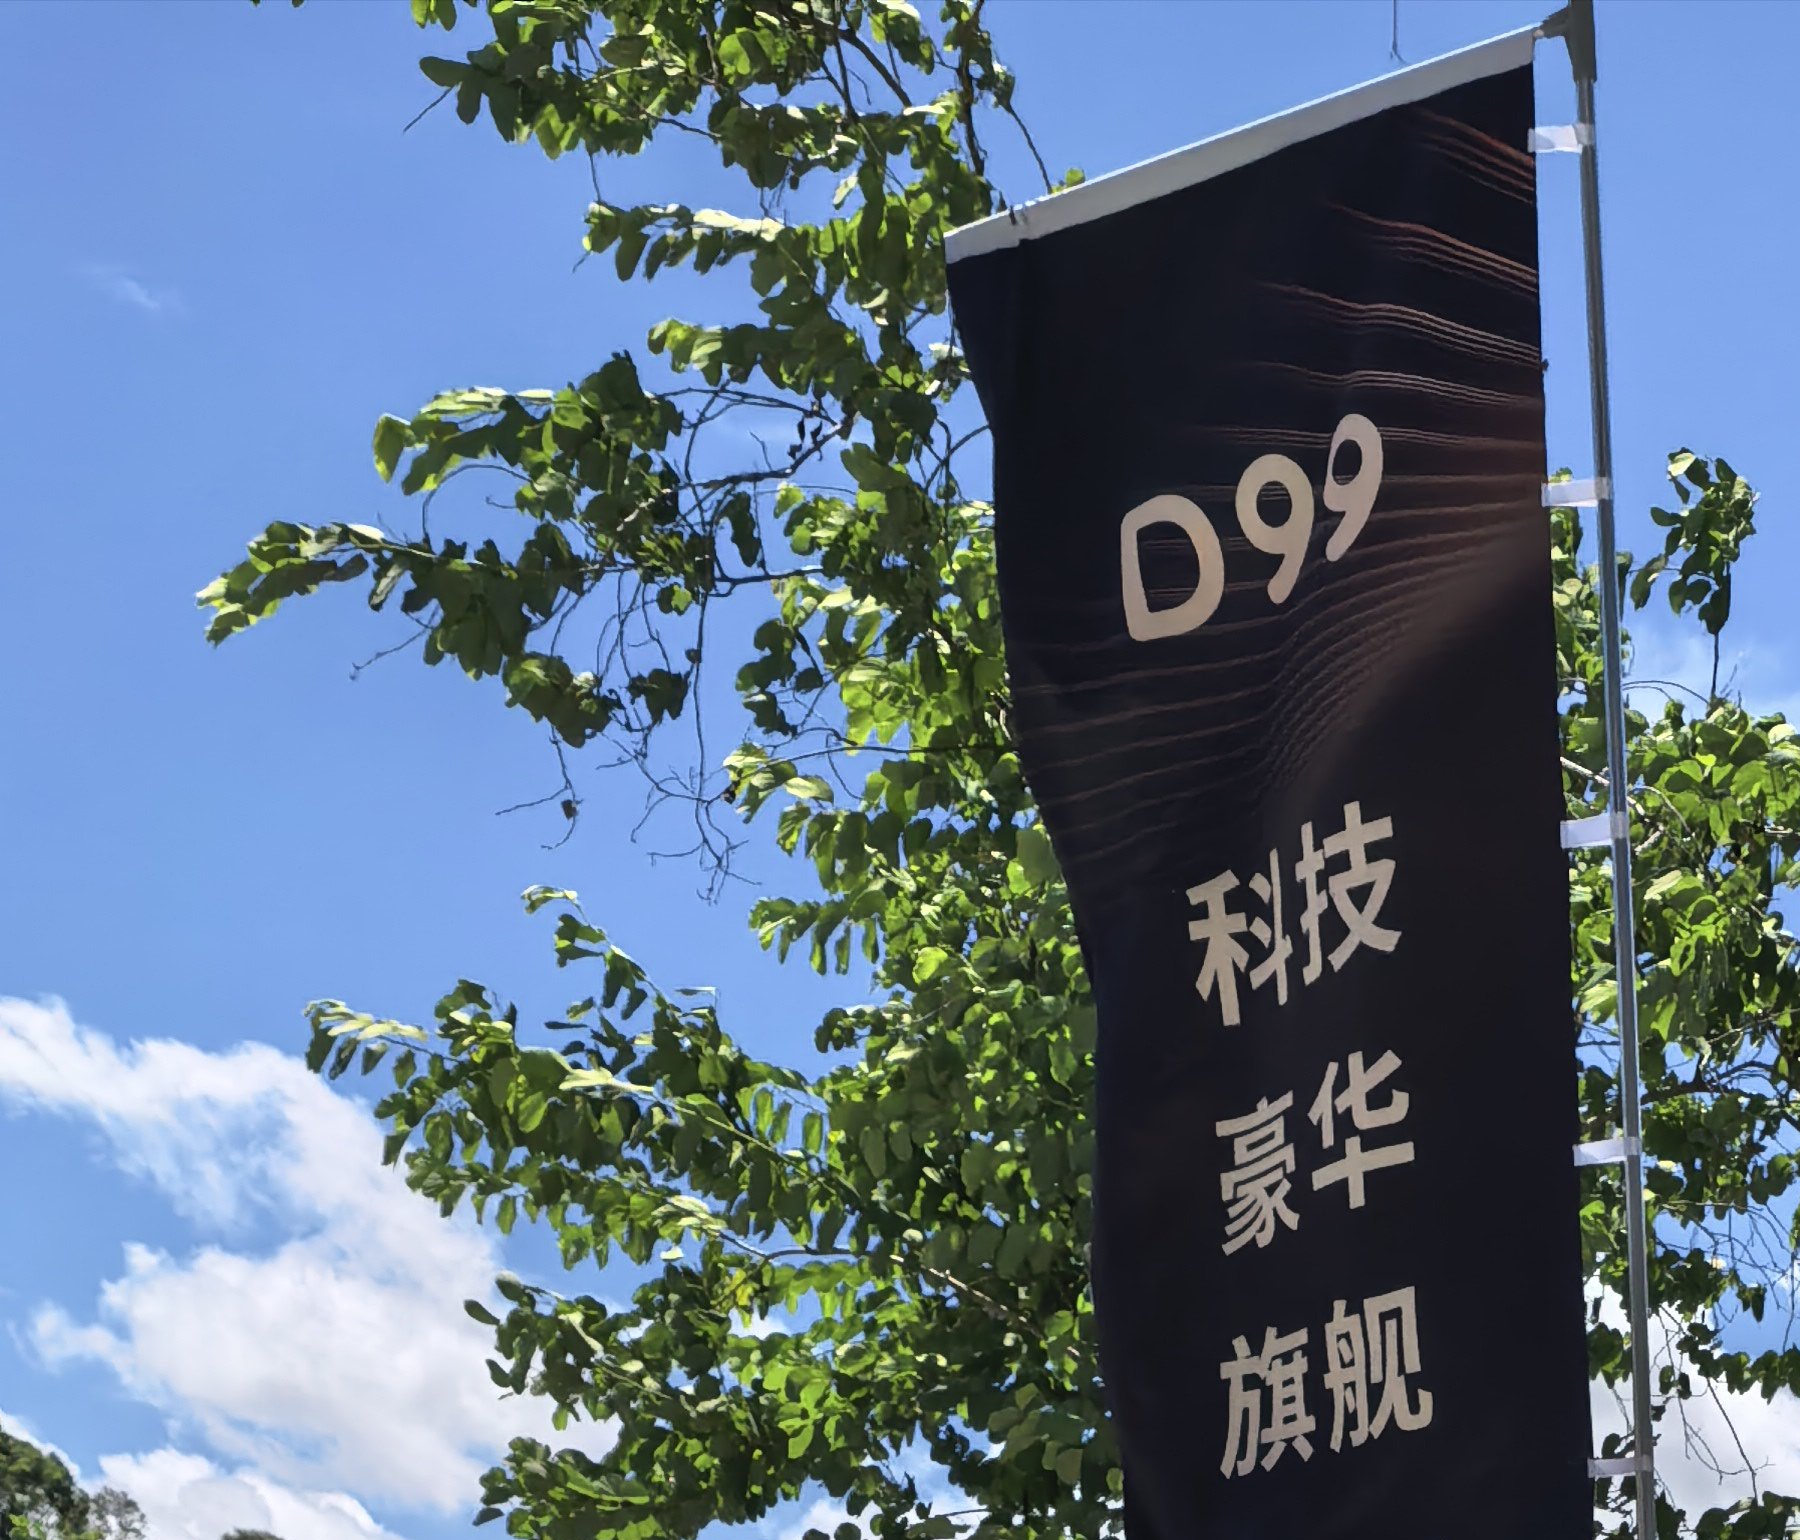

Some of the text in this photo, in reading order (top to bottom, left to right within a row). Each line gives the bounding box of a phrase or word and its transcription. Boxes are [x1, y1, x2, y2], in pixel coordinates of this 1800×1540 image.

[1121, 413, 1384, 641] D99
[1186, 800, 1402, 1027] 科技
[1215, 1049, 1415, 1256] 豪华
[1220, 1285, 1434, 1480] 旗舰
